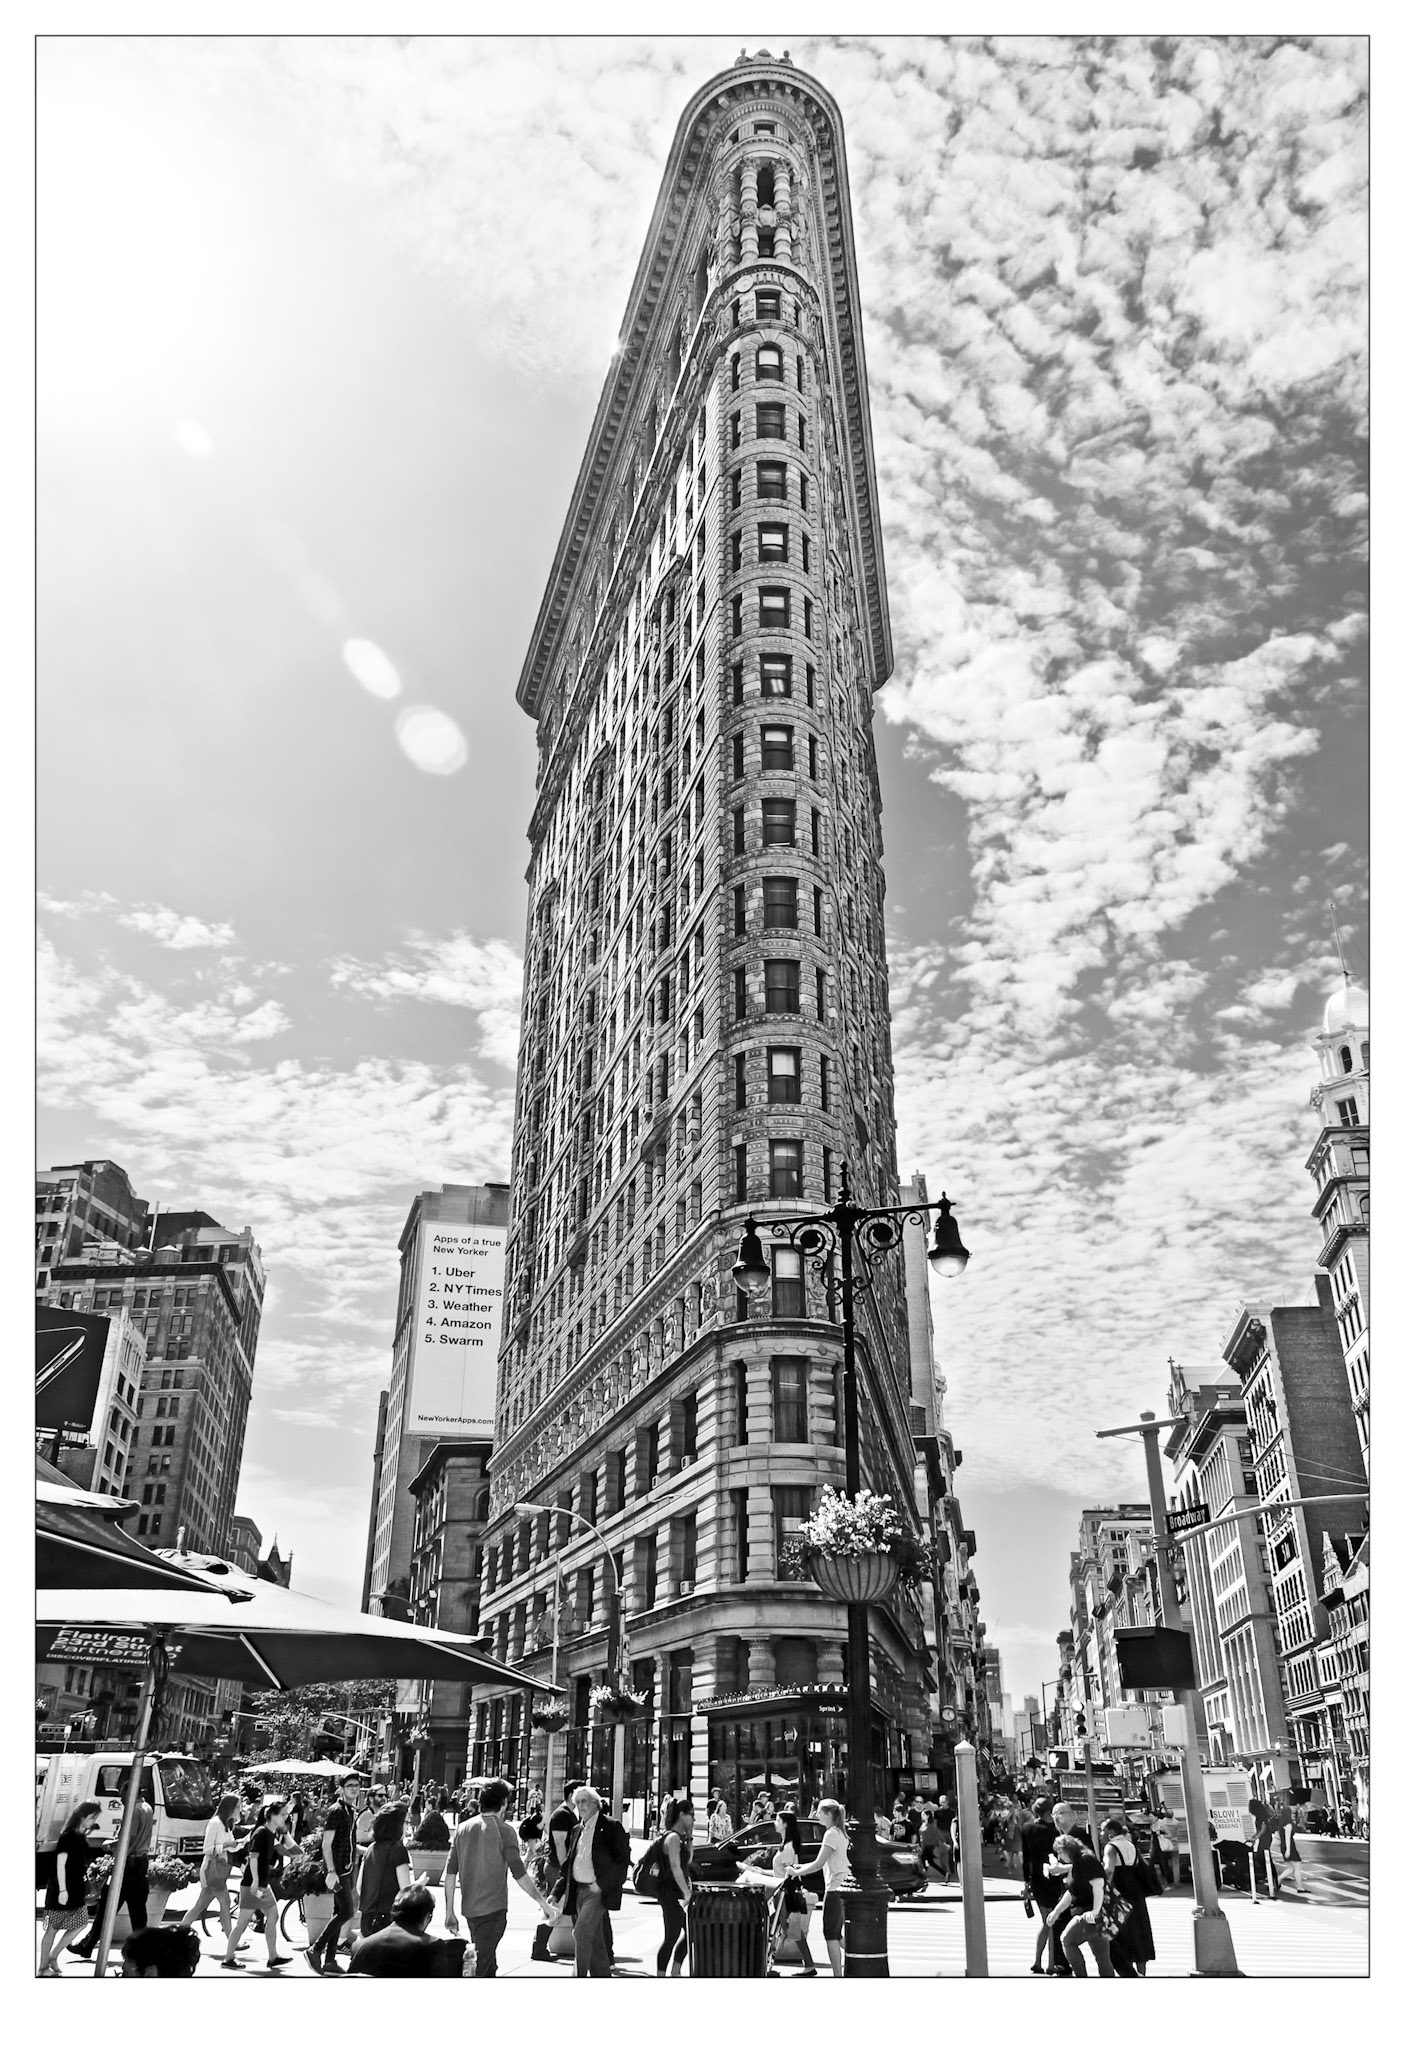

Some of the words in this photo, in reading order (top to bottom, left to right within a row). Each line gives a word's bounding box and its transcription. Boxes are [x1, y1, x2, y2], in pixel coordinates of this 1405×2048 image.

[433, 1235, 459, 1244] Apps
[482, 1239, 501, 1247] true
[433, 1245, 455, 1254] New
[457, 1247, 489, 1256] Yorker
[432, 1267, 442, 1275] 1.
[445, 1267, 476, 1278] Uber
[429, 1283, 440, 1292] 2.
[427, 1299, 438, 1309] 3.
[443, 1300, 494, 1312] Weather
[426, 1316, 437, 1326] 4.
[440, 1317, 492, 1330] Amazon
[424, 1334, 435, 1343] 5.
[439, 1334, 484, 1347] Swarm
[417, 1415, 494, 1425] NewYorkerApps.com
[1169, 1509, 1206, 1530] Broadway
[54, 1637, 109, 1647] 23rd
[113, 1641, 183, 1653] Stret
[818, 1705, 836, 1713] Sprint
